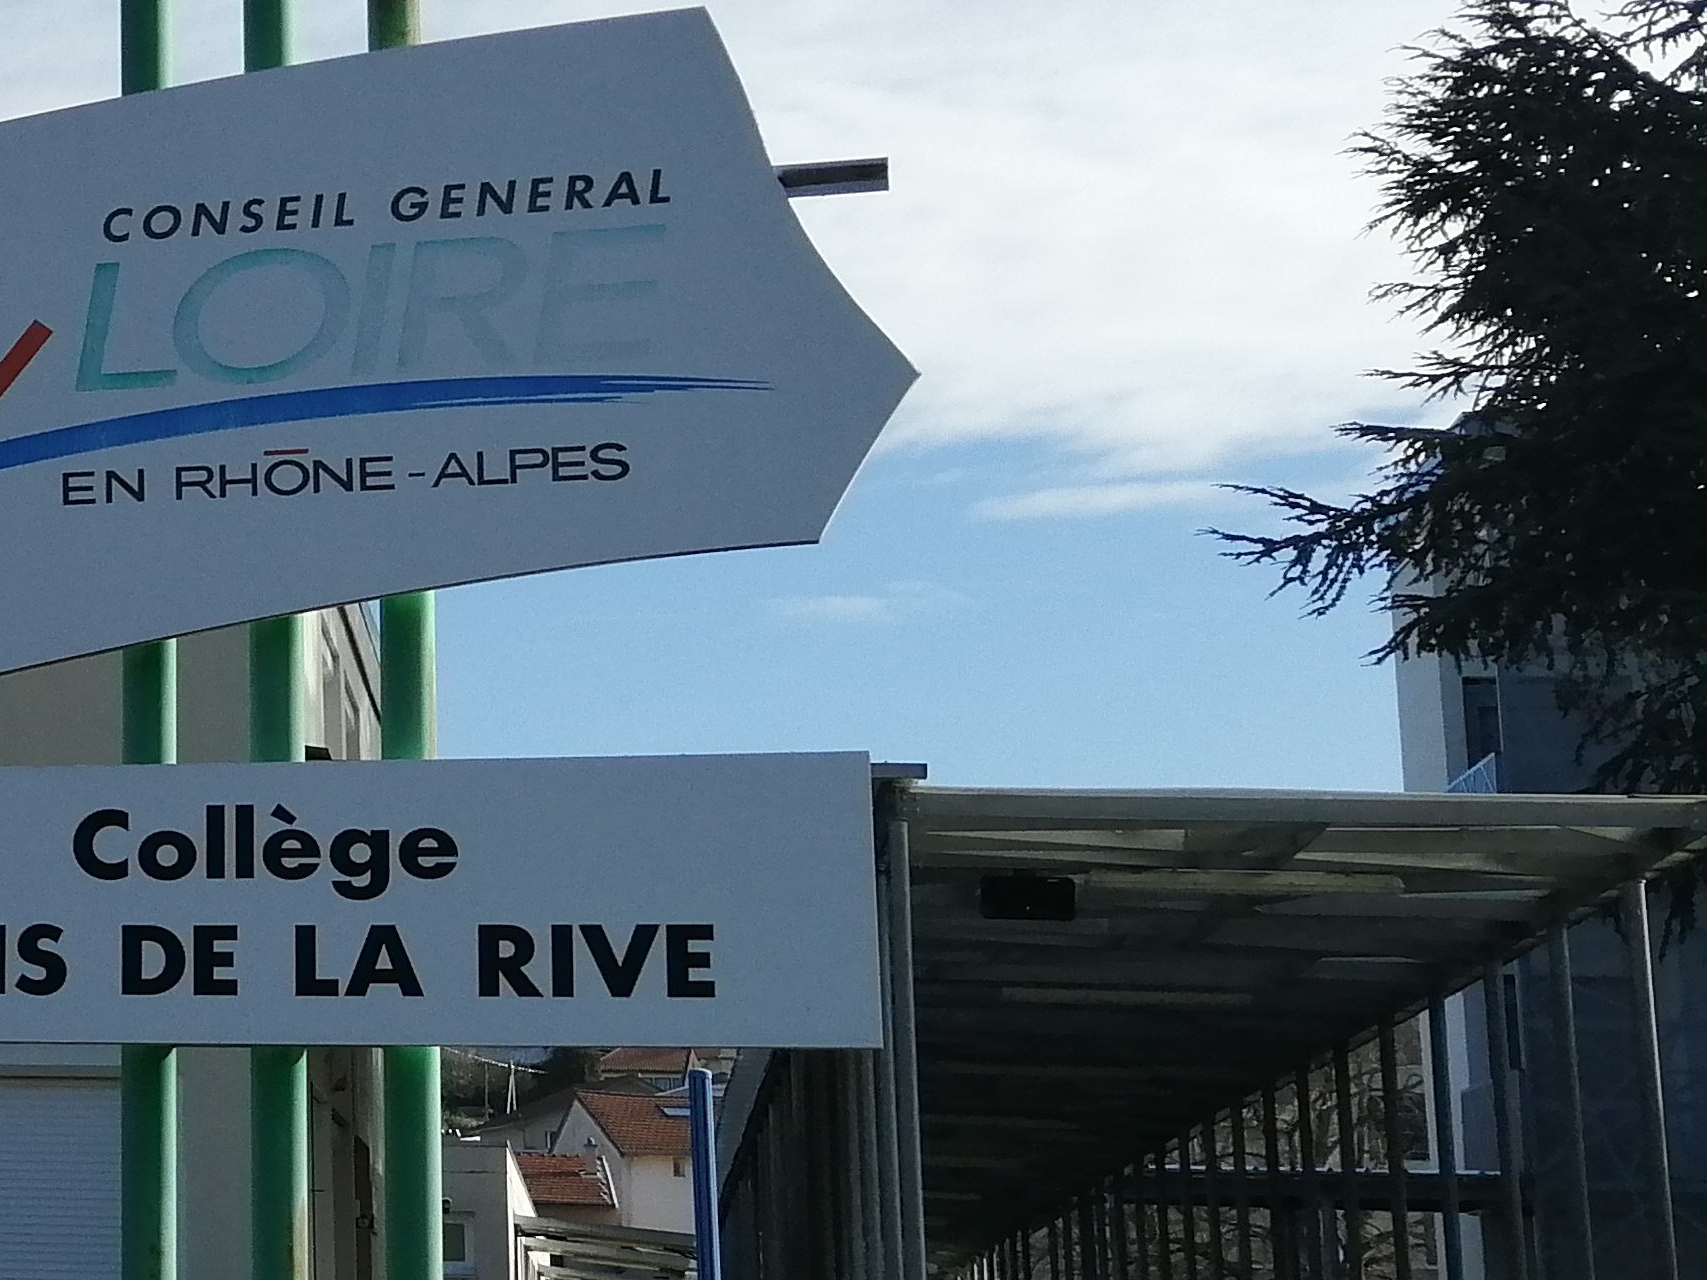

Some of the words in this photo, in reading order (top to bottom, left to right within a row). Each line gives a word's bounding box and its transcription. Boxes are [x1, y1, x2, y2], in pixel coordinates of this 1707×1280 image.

[102, 191, 356, 243] CONSEIL
[389, 168, 673, 223] GENERAL
[74, 223, 668, 392] LOIRE
[61, 469, 146, 506] EN
[71, 803, 459, 901] Collège
[120, 923, 240, 998] DE
[293, 923, 425, 998] LA
[477, 923, 717, 999] RIVE
